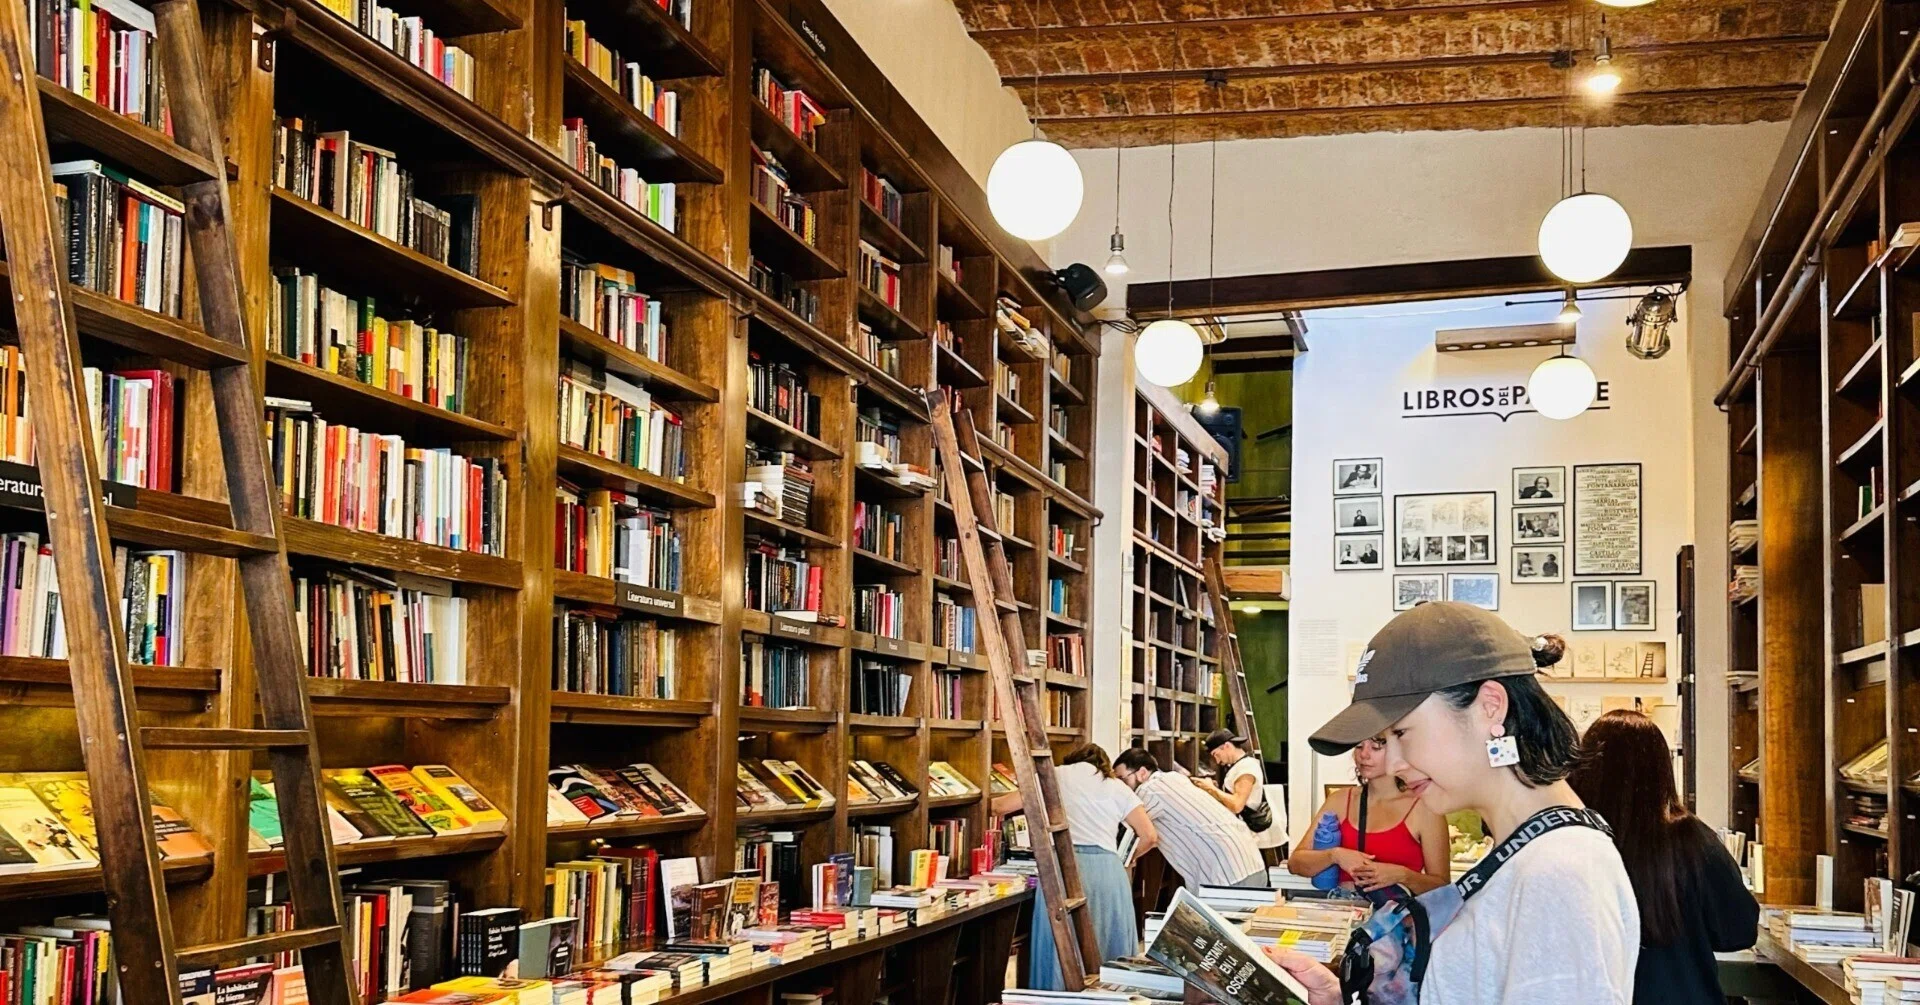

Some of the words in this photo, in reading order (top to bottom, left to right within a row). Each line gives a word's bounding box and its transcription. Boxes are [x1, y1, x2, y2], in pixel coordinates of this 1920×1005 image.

[1404, 387, 1495, 410] LIBROS
[1498, 386, 1509, 406] DEL
[627, 590, 653, 604] Literatura
[653, 597, 676, 610] universal
[1496, 809, 1581, 862] UNDER
[1193, 936, 1208, 950] UN
[1199, 940, 1227, 972] INSTANTE
[1219, 962, 1231, 975] EN
[1229, 954, 1239, 967] LA
[217, 987, 226, 995] La
[226, 982, 259, 993] habitación
